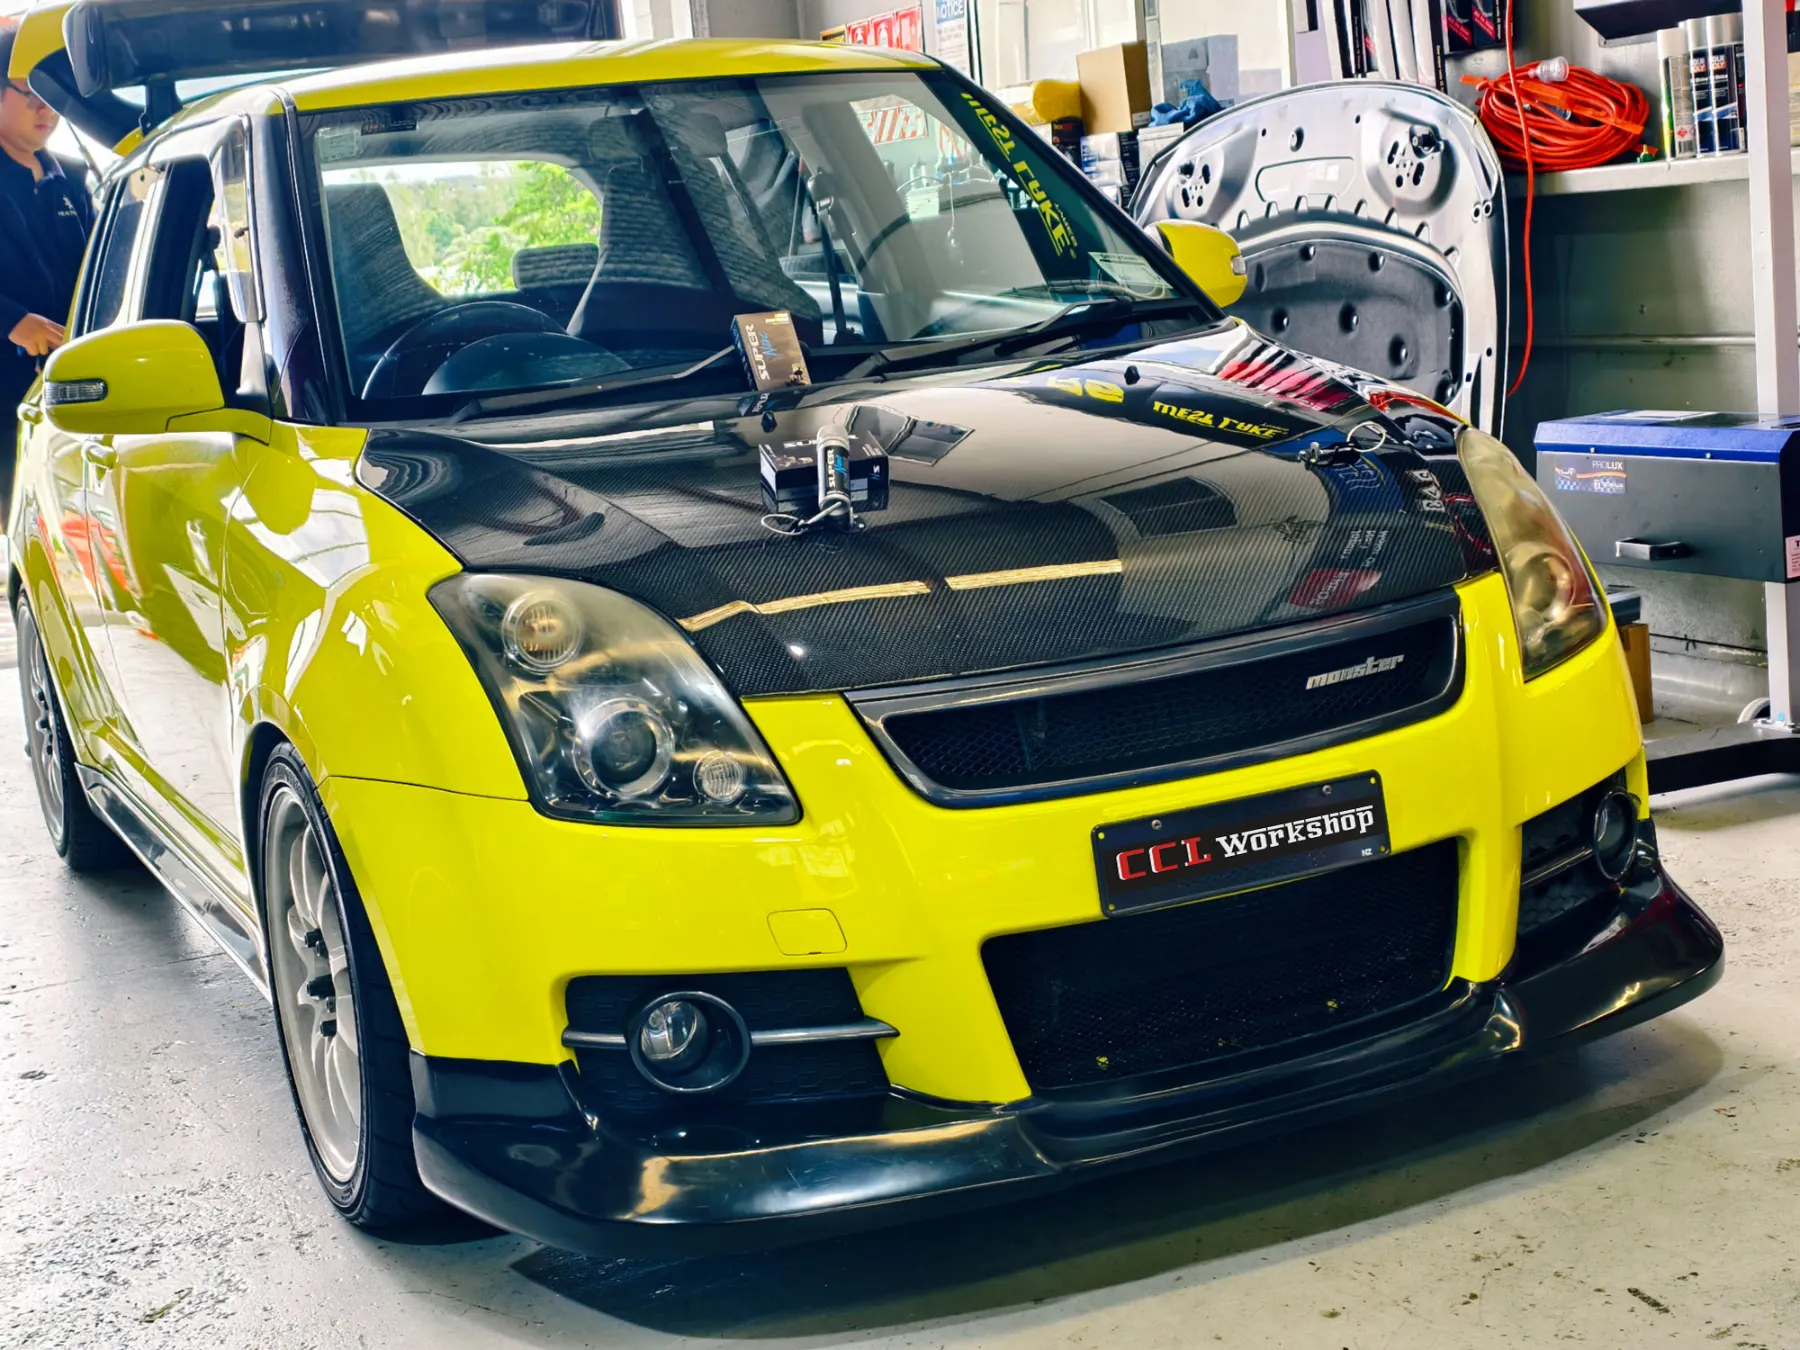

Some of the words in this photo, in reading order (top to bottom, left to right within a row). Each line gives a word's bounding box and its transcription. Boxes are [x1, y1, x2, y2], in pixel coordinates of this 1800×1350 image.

[745, 323, 771, 381] SUPER
[827, 448, 837, 488] SUPER
[1591, 460, 1624, 470] PROLUX
[1305, 654, 1404, 690] monster
[1115, 836, 1212, 880] CCL
[1215, 805, 1374, 859] Workshop
[1361, 847, 1373, 857] NZ
